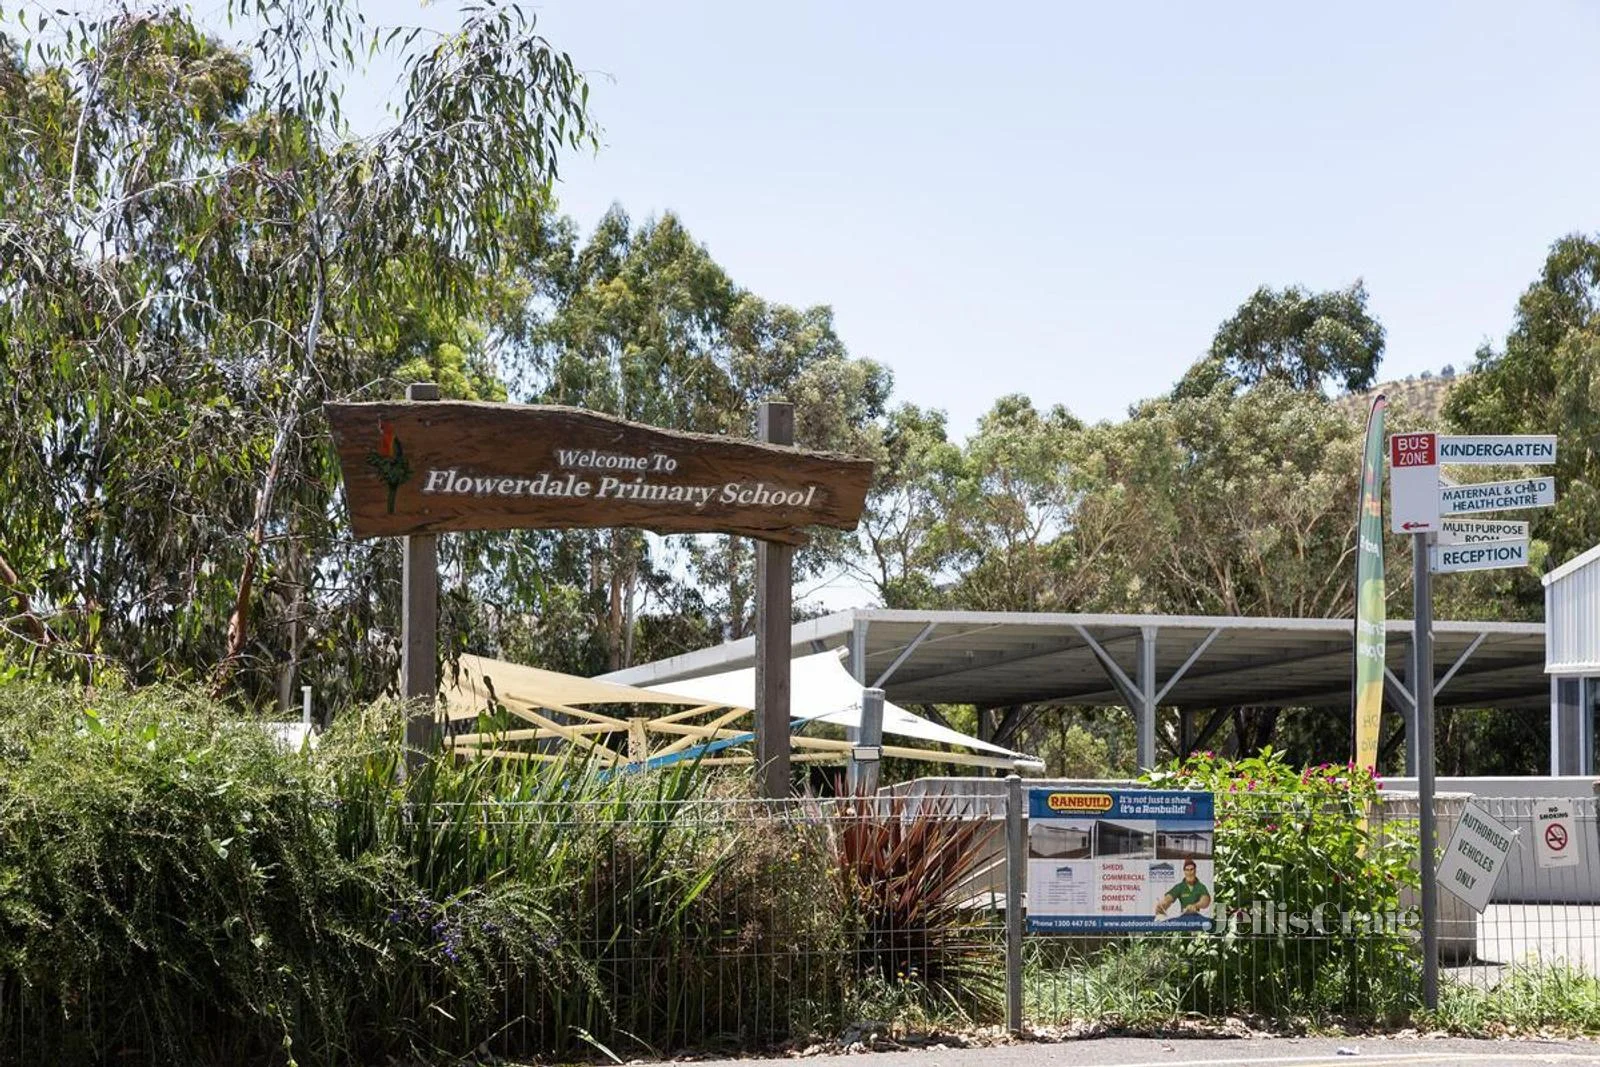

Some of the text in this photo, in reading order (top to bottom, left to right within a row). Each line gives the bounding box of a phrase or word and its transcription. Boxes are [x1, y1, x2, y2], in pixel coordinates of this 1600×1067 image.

[1398, 437, 1429, 450] BUS
[1440, 443, 1553, 456] KINDERGARTEN
[556, 449, 677, 472] Welcome To
[1400, 451, 1428, 465] ZONE
[423, 469, 816, 507] Flowerdale Primary School
[1442, 481, 1546, 501] MATERNAL & CHILD
[1453, 494, 1537, 511] HEALTH CENTRE
[1442, 522, 1523, 535] MULTI PURPOSE
[1443, 546, 1522, 565] RECEPTION
[1051, 796, 1111, 808] RANBUILD
[1133, 796, 1147, 804] not
[1148, 796, 1164, 805] just
[1135, 806, 1142, 814] a
[1142, 804, 1186, 814] Ranbuild!
[1539, 812, 1568, 820] SMOKING
[1461, 812, 1510, 853] AUTHORISED
[1457, 838, 1495, 873] VEHICLES
[1102, 873, 1145, 881] COMMERCIAL
[1455, 868, 1477, 890] ONLY
